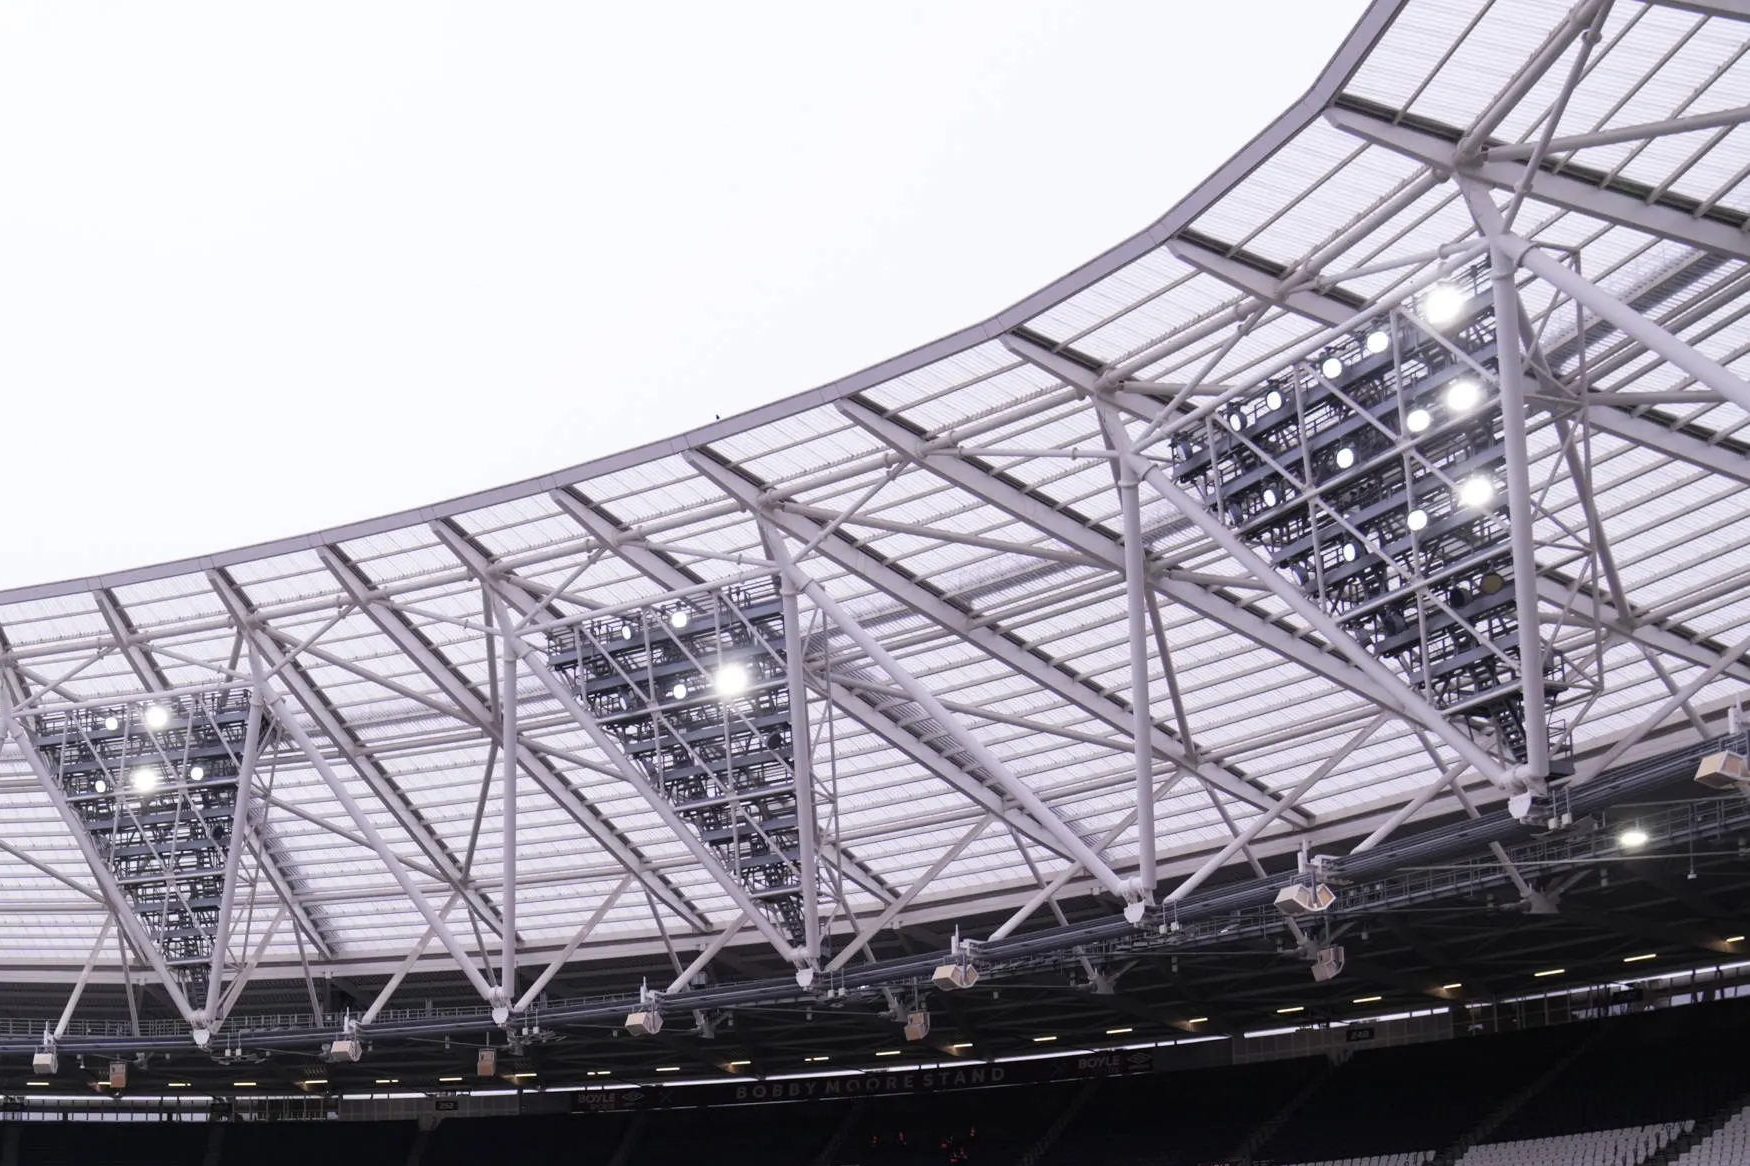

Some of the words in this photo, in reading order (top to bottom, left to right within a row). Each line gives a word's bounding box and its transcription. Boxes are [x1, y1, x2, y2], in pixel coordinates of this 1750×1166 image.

[737, 1079, 817, 1099] BOBBY
[825, 1072, 915, 1094] MOORE
[923, 1067, 1005, 1088] STAND
